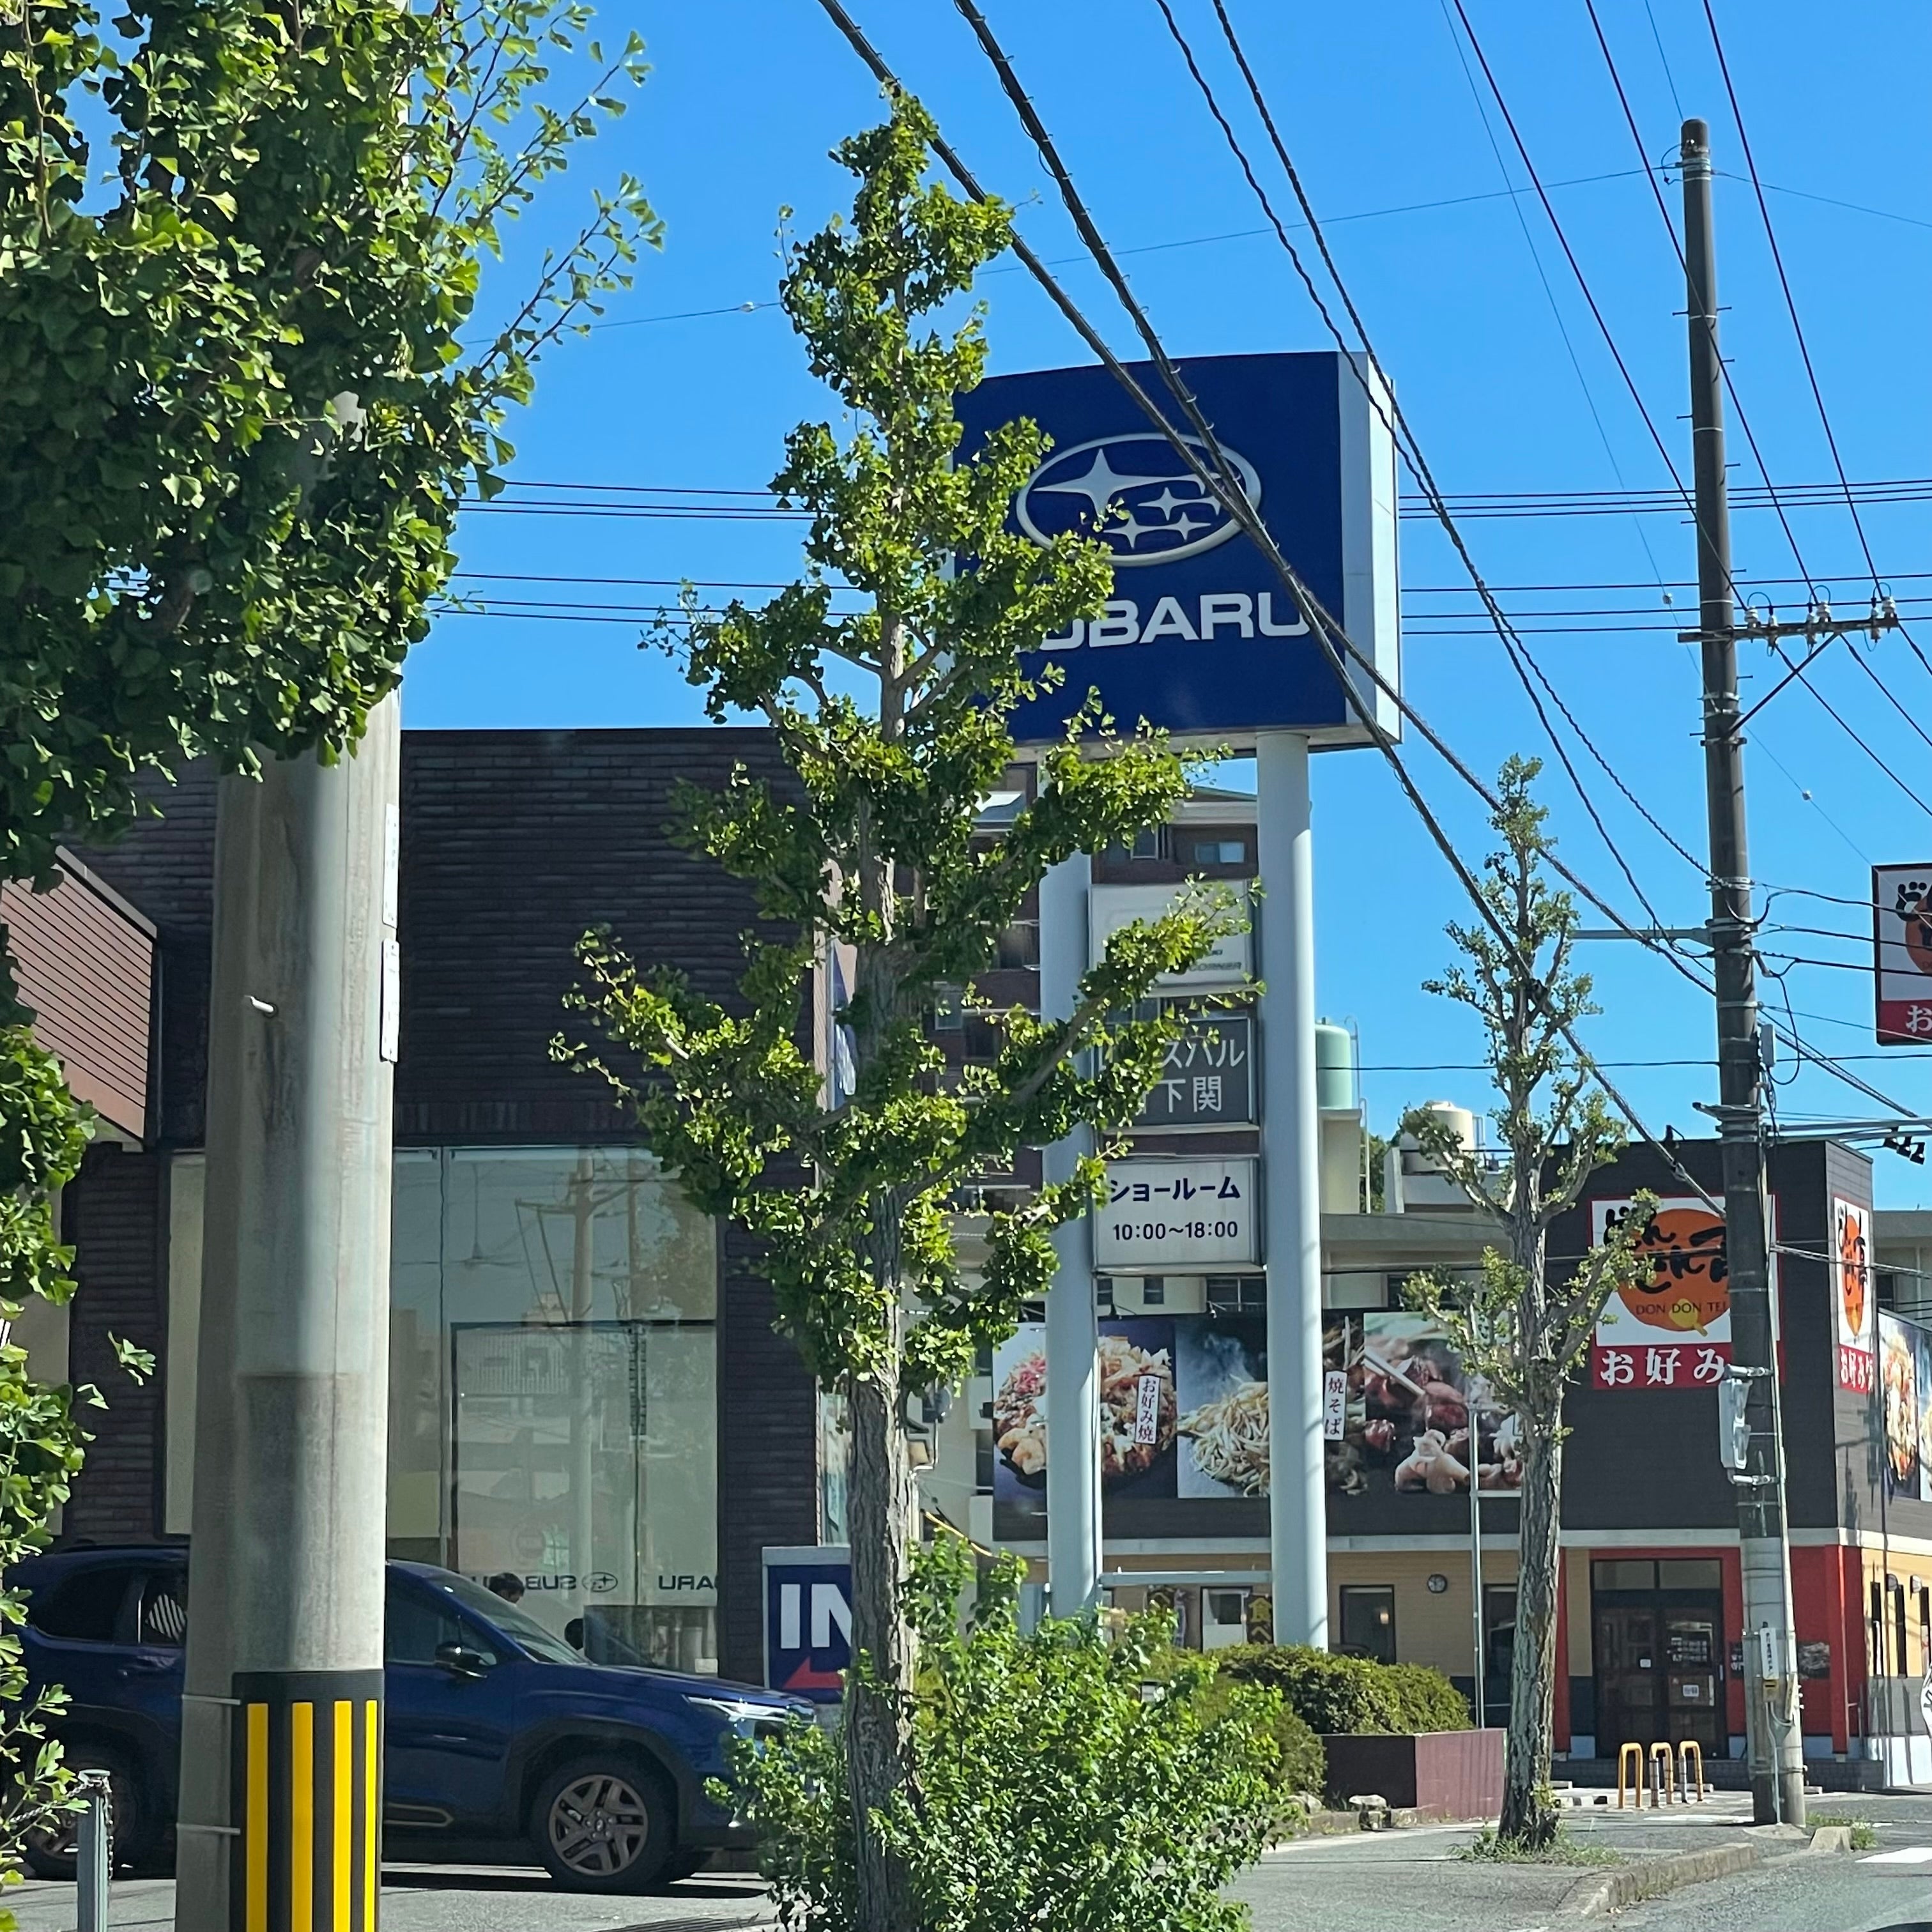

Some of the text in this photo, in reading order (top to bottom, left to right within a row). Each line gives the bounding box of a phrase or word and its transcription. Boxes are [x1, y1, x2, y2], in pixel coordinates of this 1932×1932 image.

[1015, 592, 1311, 654] BARU
[1137, 1075, 1222, 1114] 下関
[1110, 1176, 1241, 1202] ショールーム
[1636, 1303, 1666, 1315] DON
[1672, 1303, 1702, 1314] DON
[1138, 1378, 1156, 1441] お好み焼
[1325, 1377, 1344, 1435] 焼そば
[781, 1584, 852, 1649] IN
